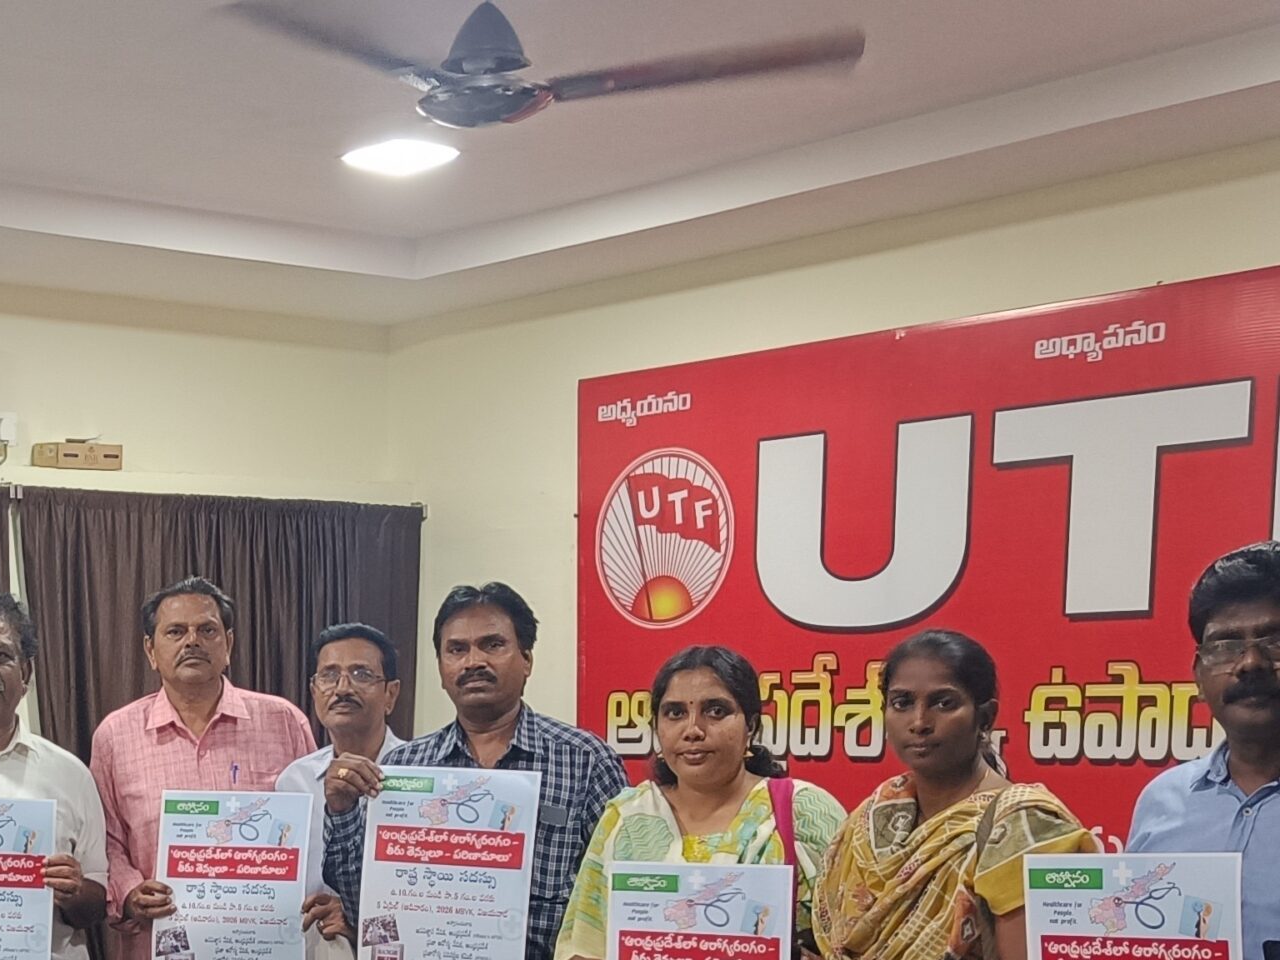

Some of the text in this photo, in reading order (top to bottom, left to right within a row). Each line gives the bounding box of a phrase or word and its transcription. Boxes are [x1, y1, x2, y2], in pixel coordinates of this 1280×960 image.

[1035, 319, 1166, 363] అధ్యాపనం
[597, 390, 691, 427] అధ్యయనం
[636, 483, 714, 531] UTF
[756, 379, 1280, 630] UT
